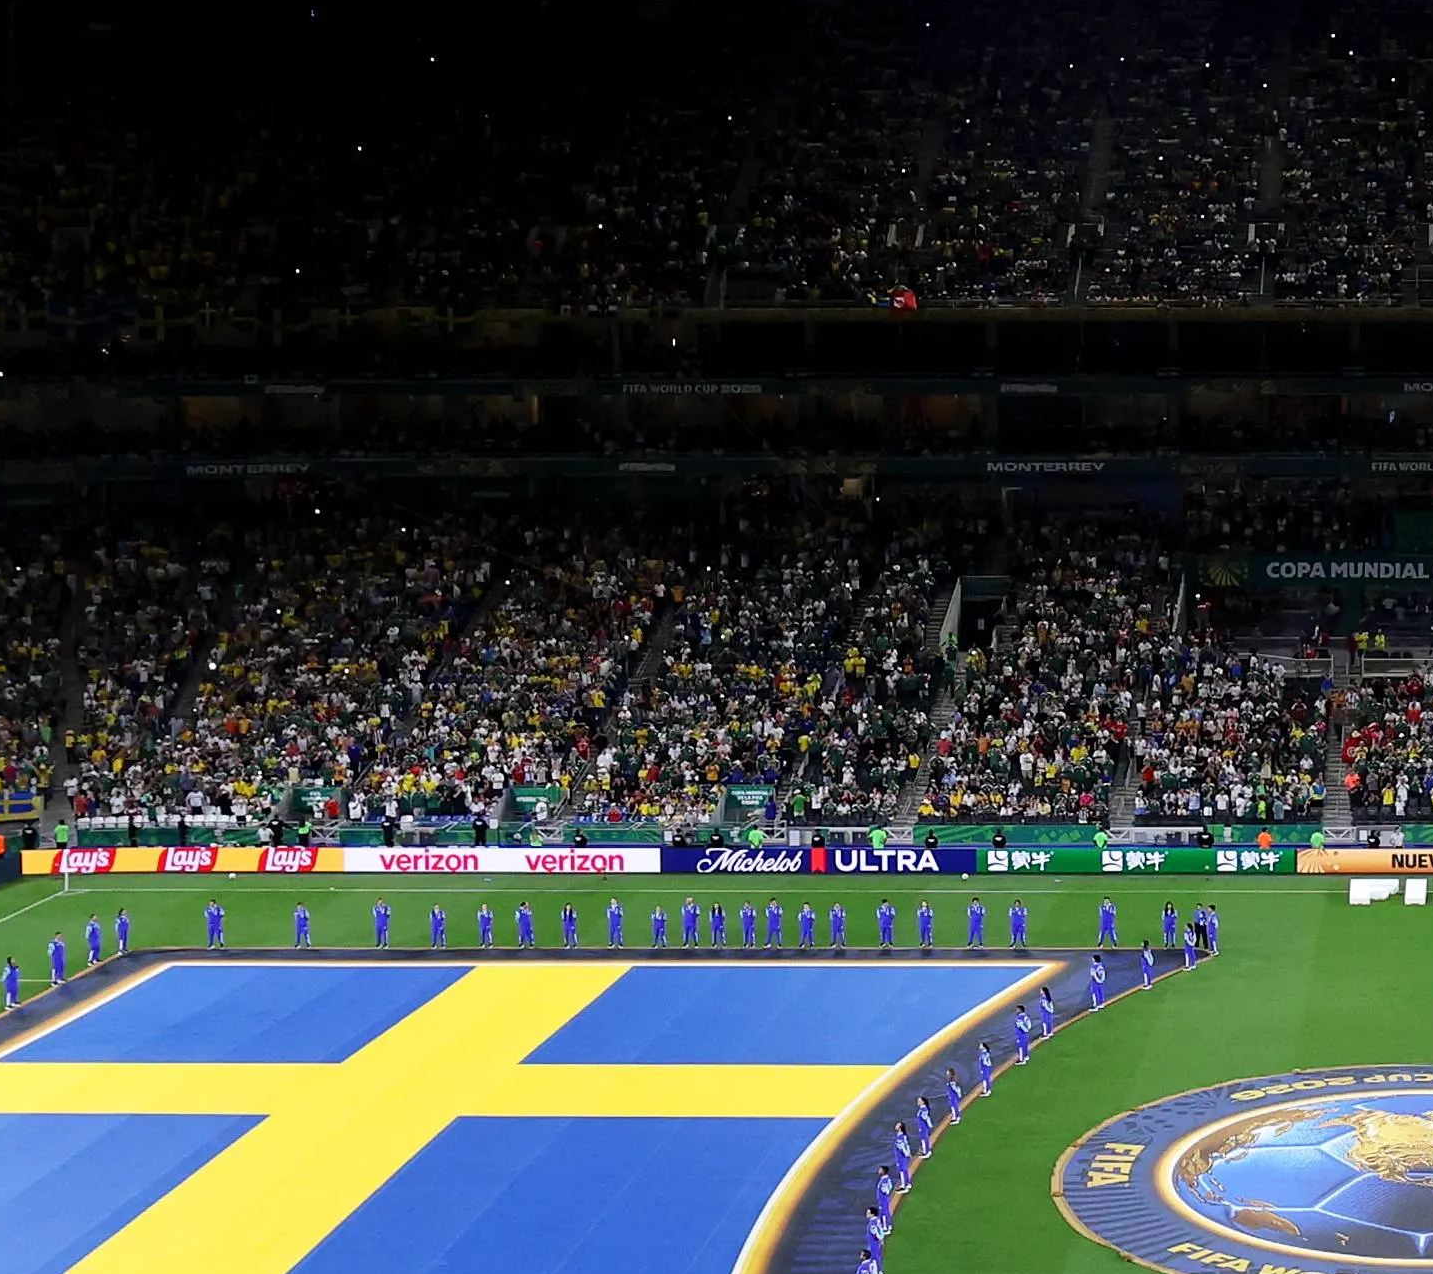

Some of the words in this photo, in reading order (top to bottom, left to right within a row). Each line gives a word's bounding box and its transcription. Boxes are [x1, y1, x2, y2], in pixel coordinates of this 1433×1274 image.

[622, 384, 648, 394] FIFA
[650, 384, 692, 394] WORLD
[694, 384, 719, 394] CUP
[186, 462, 310, 475] MONTERREY
[986, 462, 1105, 472] MONTERREY
[1371, 462, 1397, 472] FIFA
[1266, 562, 1325, 579] COPA
[1330, 562, 1430, 579] MUNDIAL
[59, 847, 111, 873] Lay's
[164, 846, 213, 872] Lay's
[264, 846, 313, 871] Lay's
[379, 849, 479, 872] verizon
[525, 850, 625, 873] verizon
[696, 847, 802, 874] Michelob
[835, 849, 940, 873] ULTRA
[1012, 851, 1049, 871] 蒙牛
[1125, 851, 1163, 871] 蒙牛
[1240, 851, 1279, 871] 蒙牛
[1229, 1075, 1364, 1103] 2026
[1088, 1142, 1142, 1190] FIFA
[1167, 1240, 1251, 1274] FIFA
